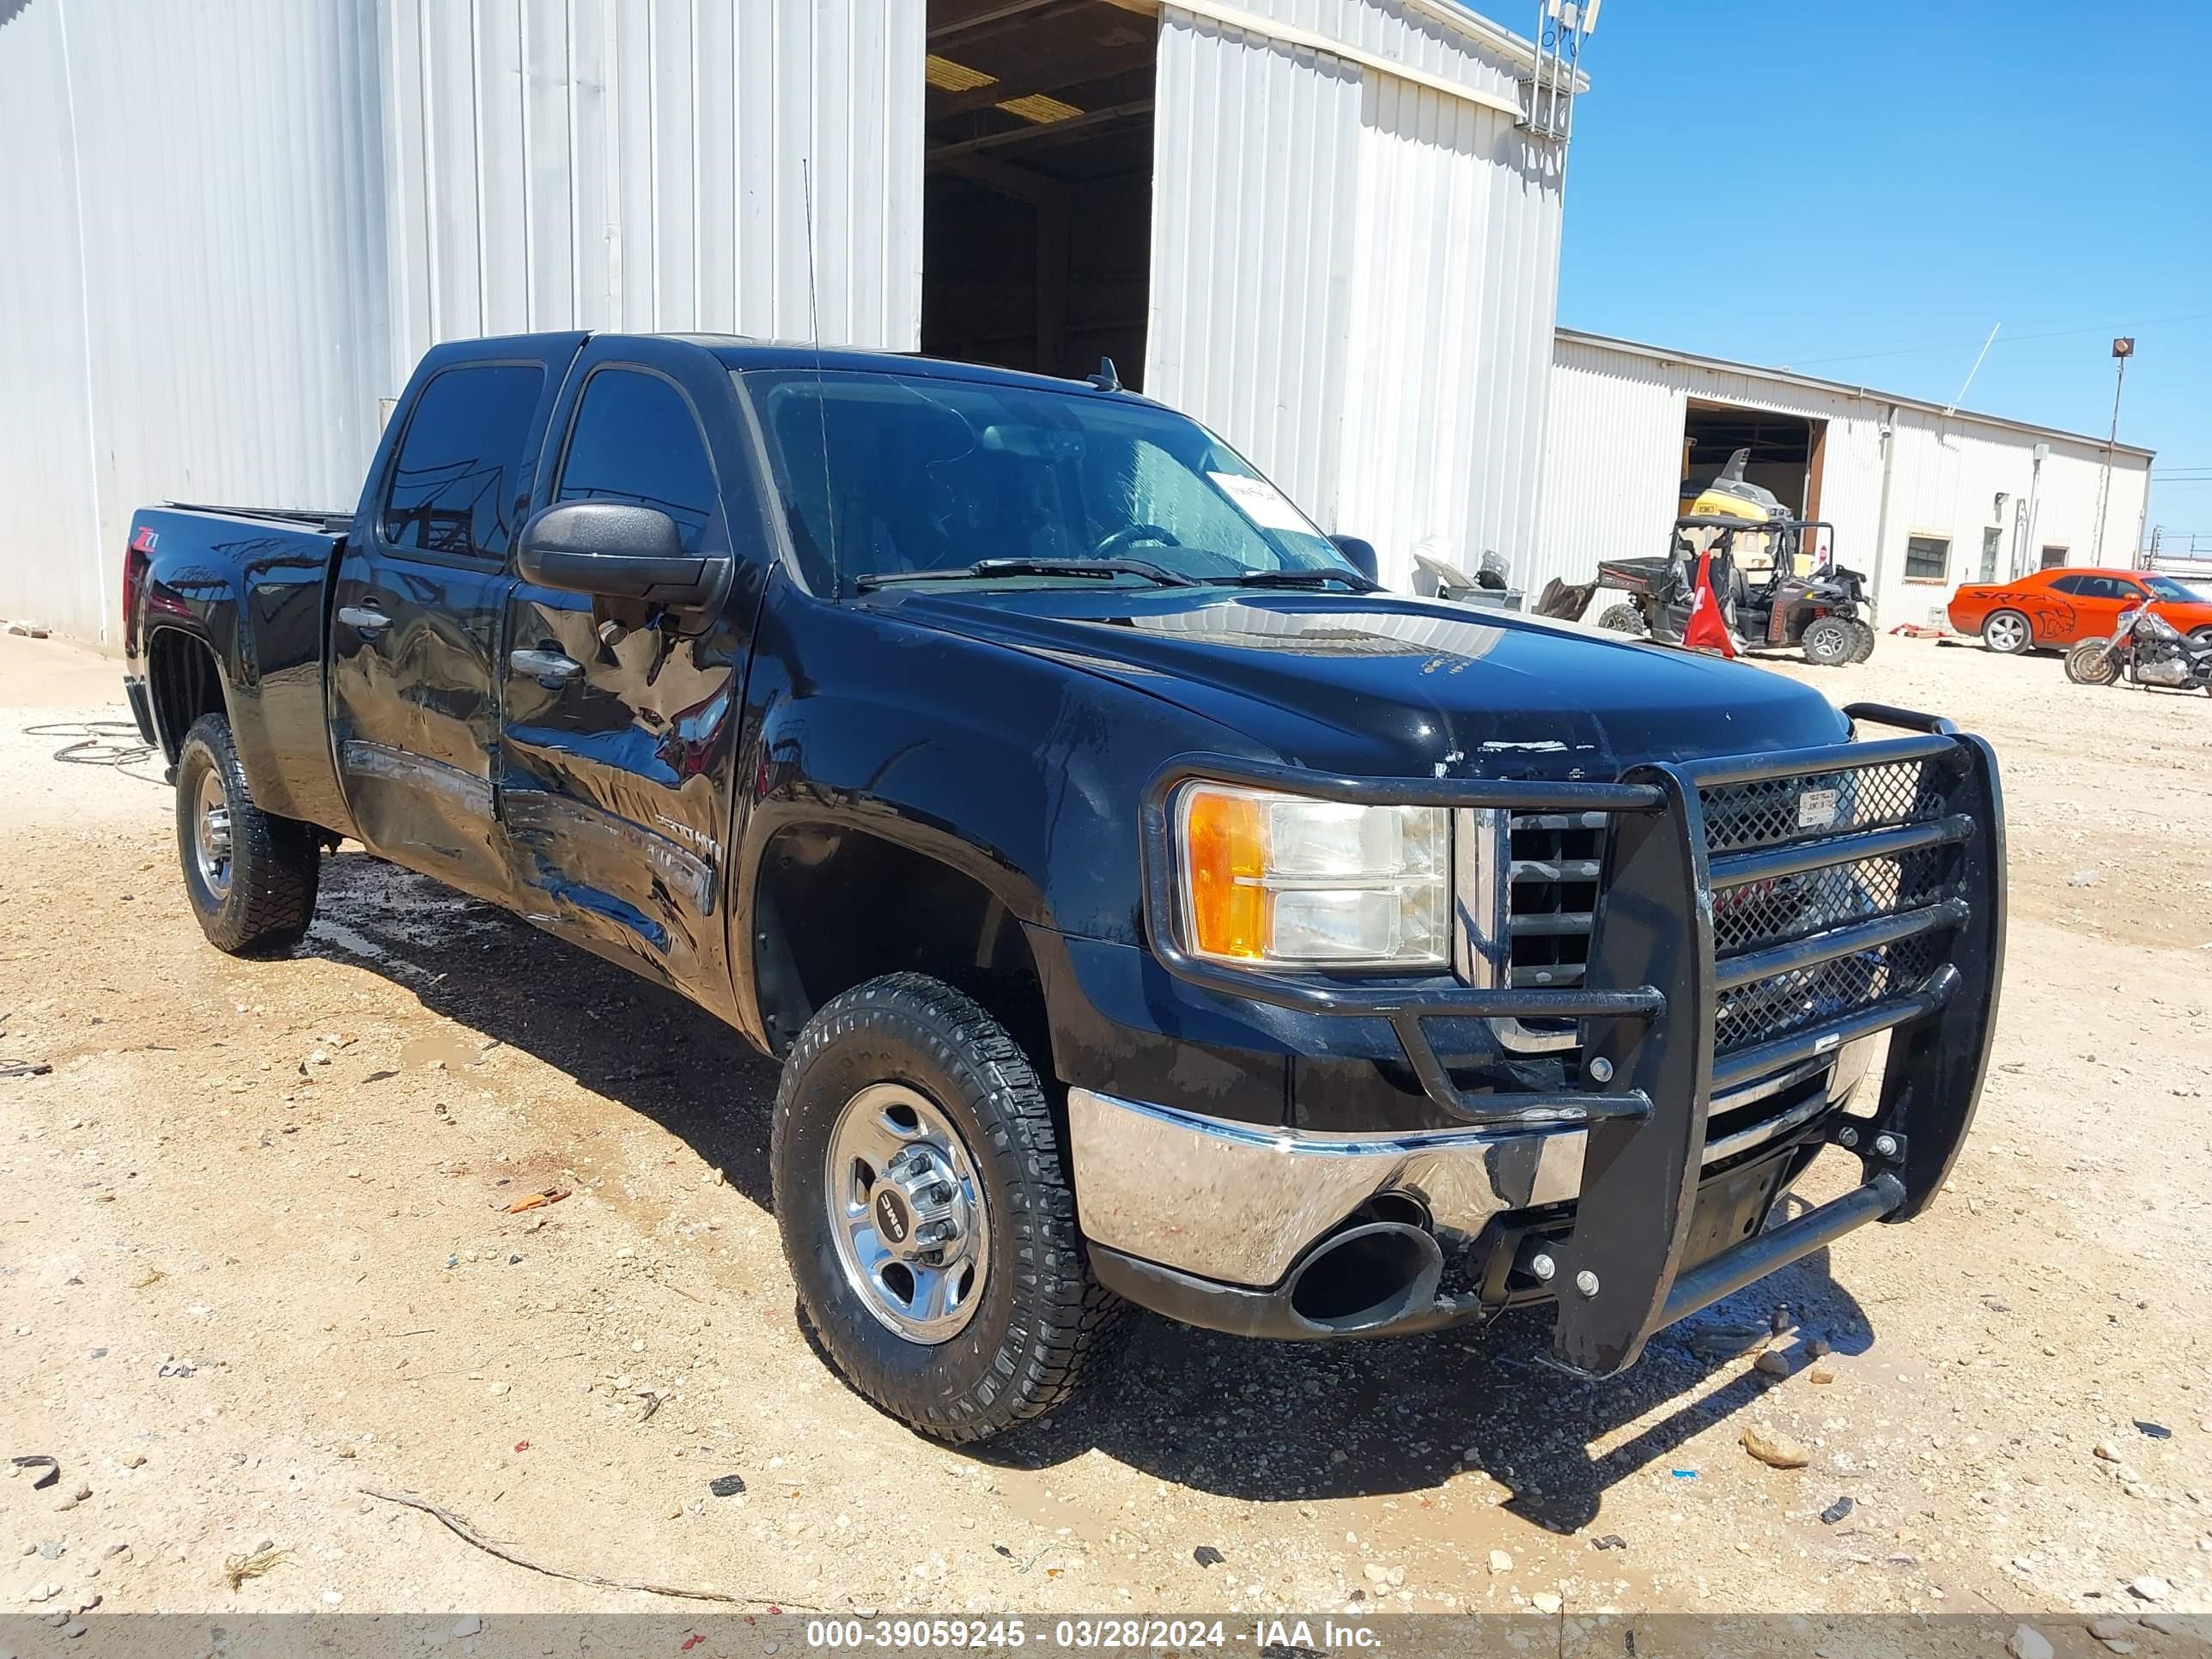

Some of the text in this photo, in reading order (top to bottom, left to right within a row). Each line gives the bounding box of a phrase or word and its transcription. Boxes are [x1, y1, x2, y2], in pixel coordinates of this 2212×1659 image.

[133, 526, 159, 552] Z71
[1966, 591, 2038, 604] SRT
[880, 1194, 904, 1239] GMC
